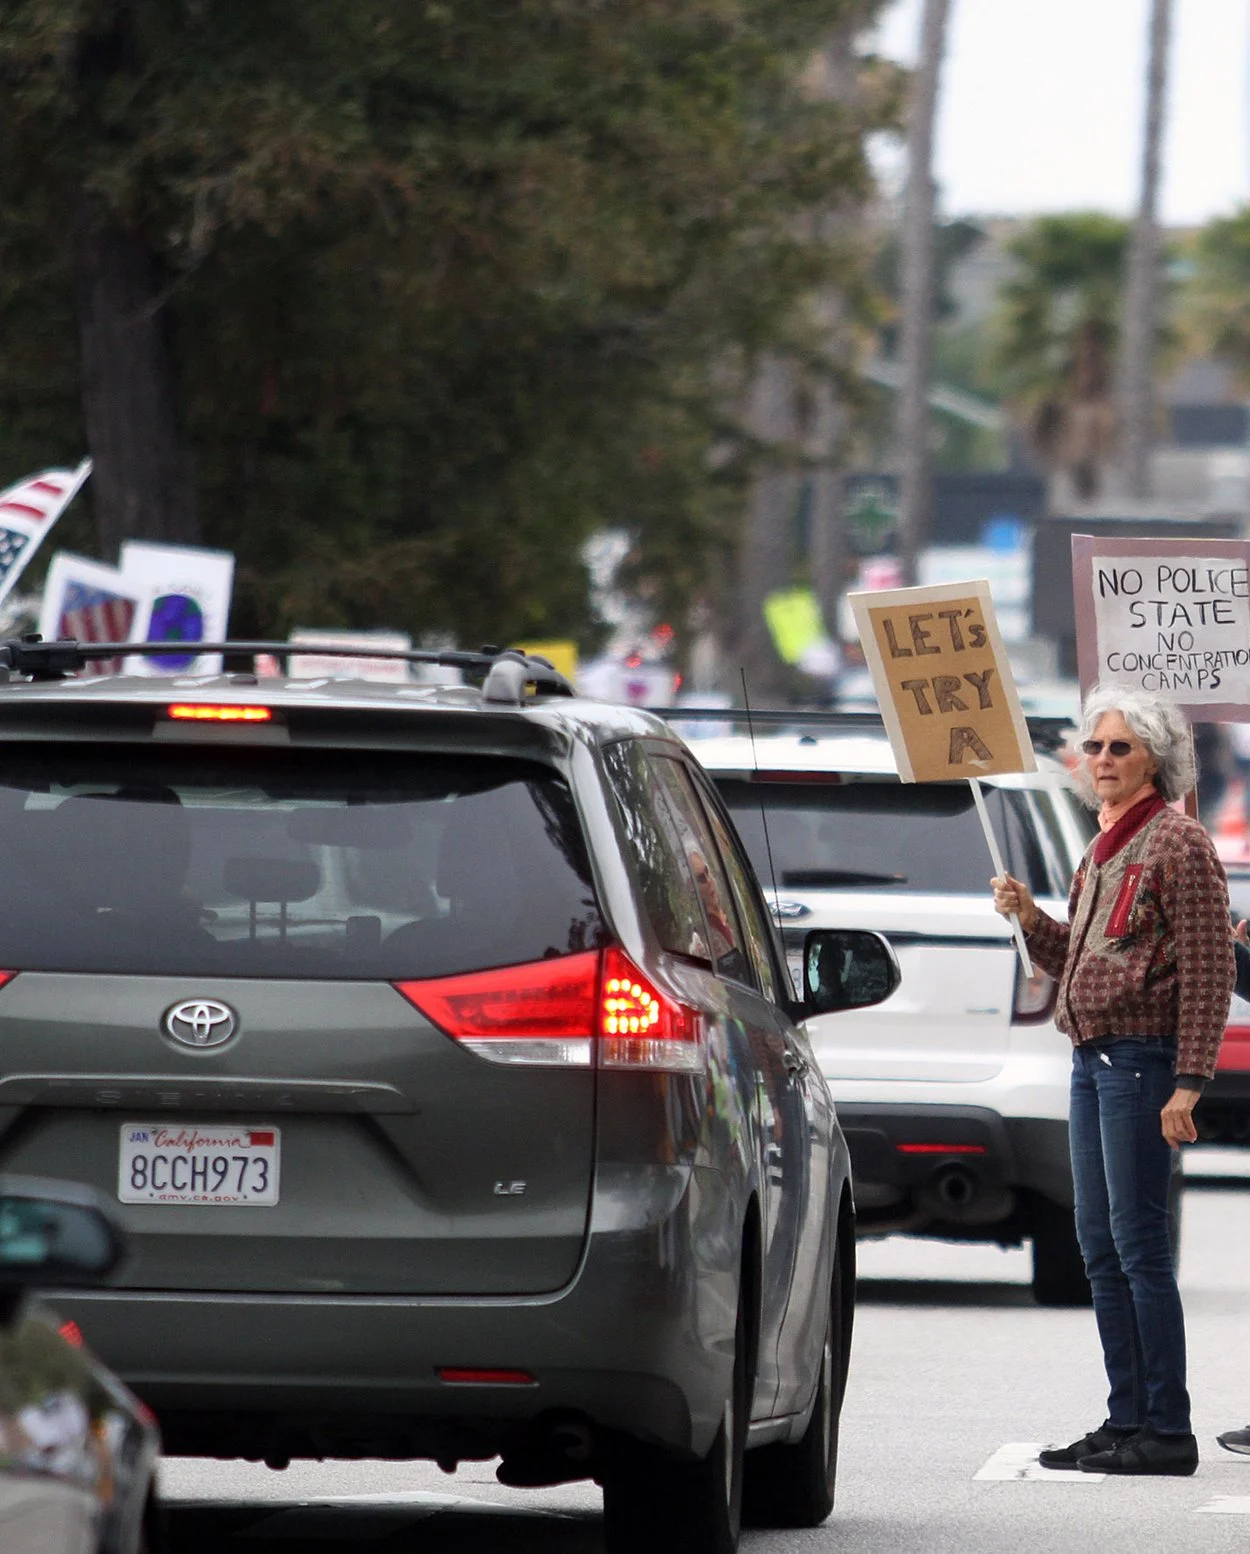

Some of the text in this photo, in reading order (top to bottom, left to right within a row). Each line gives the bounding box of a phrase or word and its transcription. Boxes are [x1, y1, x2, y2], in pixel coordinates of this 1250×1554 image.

[1099, 565, 1249, 598] NO POLICE
[1129, 600, 1236, 628] STATE
[1158, 631, 1194, 652] NO
[901, 668, 995, 716] TRY
[1142, 668, 1221, 691] CAMPS
[948, 726, 994, 765] A
[129, 1129, 250, 1153] JAN California
[131, 1154, 269, 1193] 8CCH973
[159, 1193, 240, 1202] dmv.ca.gov
[493, 1181, 527, 1195] LE
